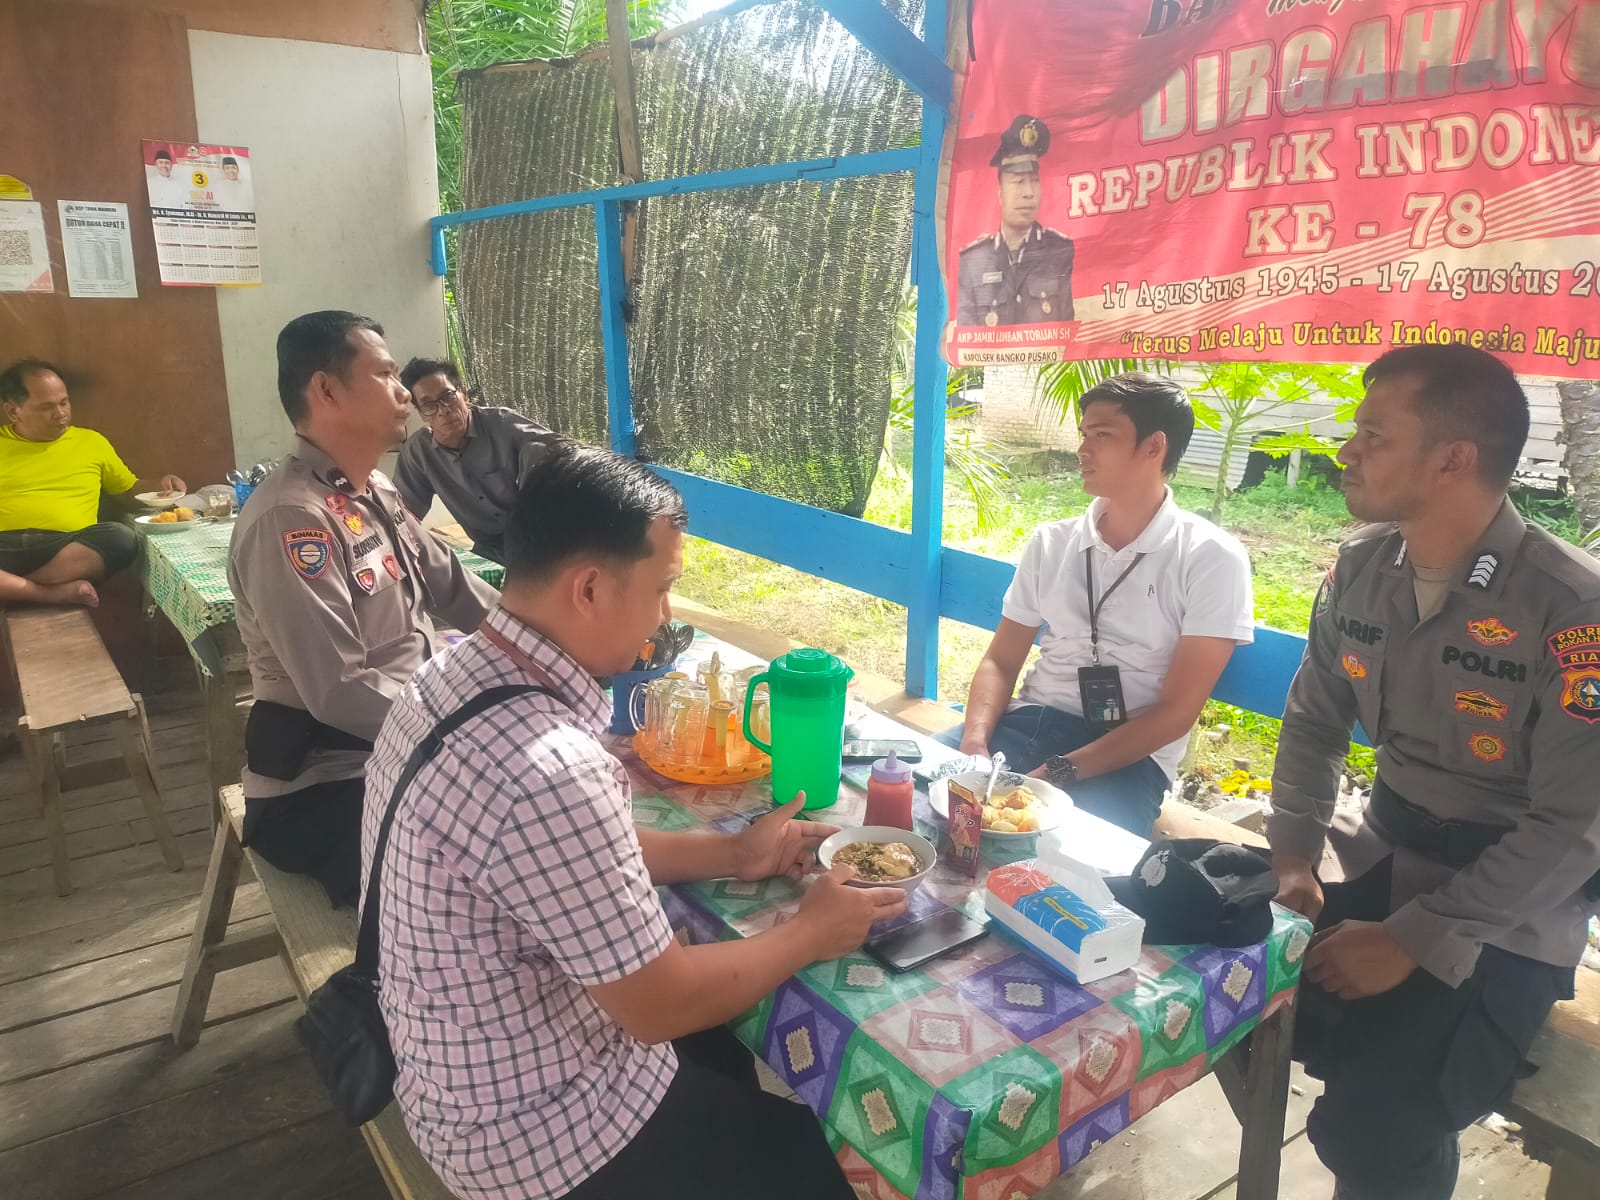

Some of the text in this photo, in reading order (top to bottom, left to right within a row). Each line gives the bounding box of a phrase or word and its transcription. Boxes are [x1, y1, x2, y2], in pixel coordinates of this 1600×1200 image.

[1068, 128, 1337, 219] REPUBLIK
[102, 220, 120, 229] CEPAT
[1242, 189, 1486, 258] KE - 78
[1102, 261, 1600, 313] 17 Agustus 1945 - 17 Agustus 2
[1024, 328, 1059, 342] TORUAN
[1059, 327, 1071, 340] SH
[1199, 322, 1283, 352] Melaju
[1293, 319, 1382, 346] Untuk
[1391, 320, 1526, 353] Indonesia
[1534, 327, 1600, 365] Maju
[963, 351, 1057, 361] KAPOLSEK BANGKO PUSAKO
[1336, 616, 1384, 645] ARIF
[1557, 636, 1590, 650] ROKAN
[1441, 646, 1527, 682] POLRI
